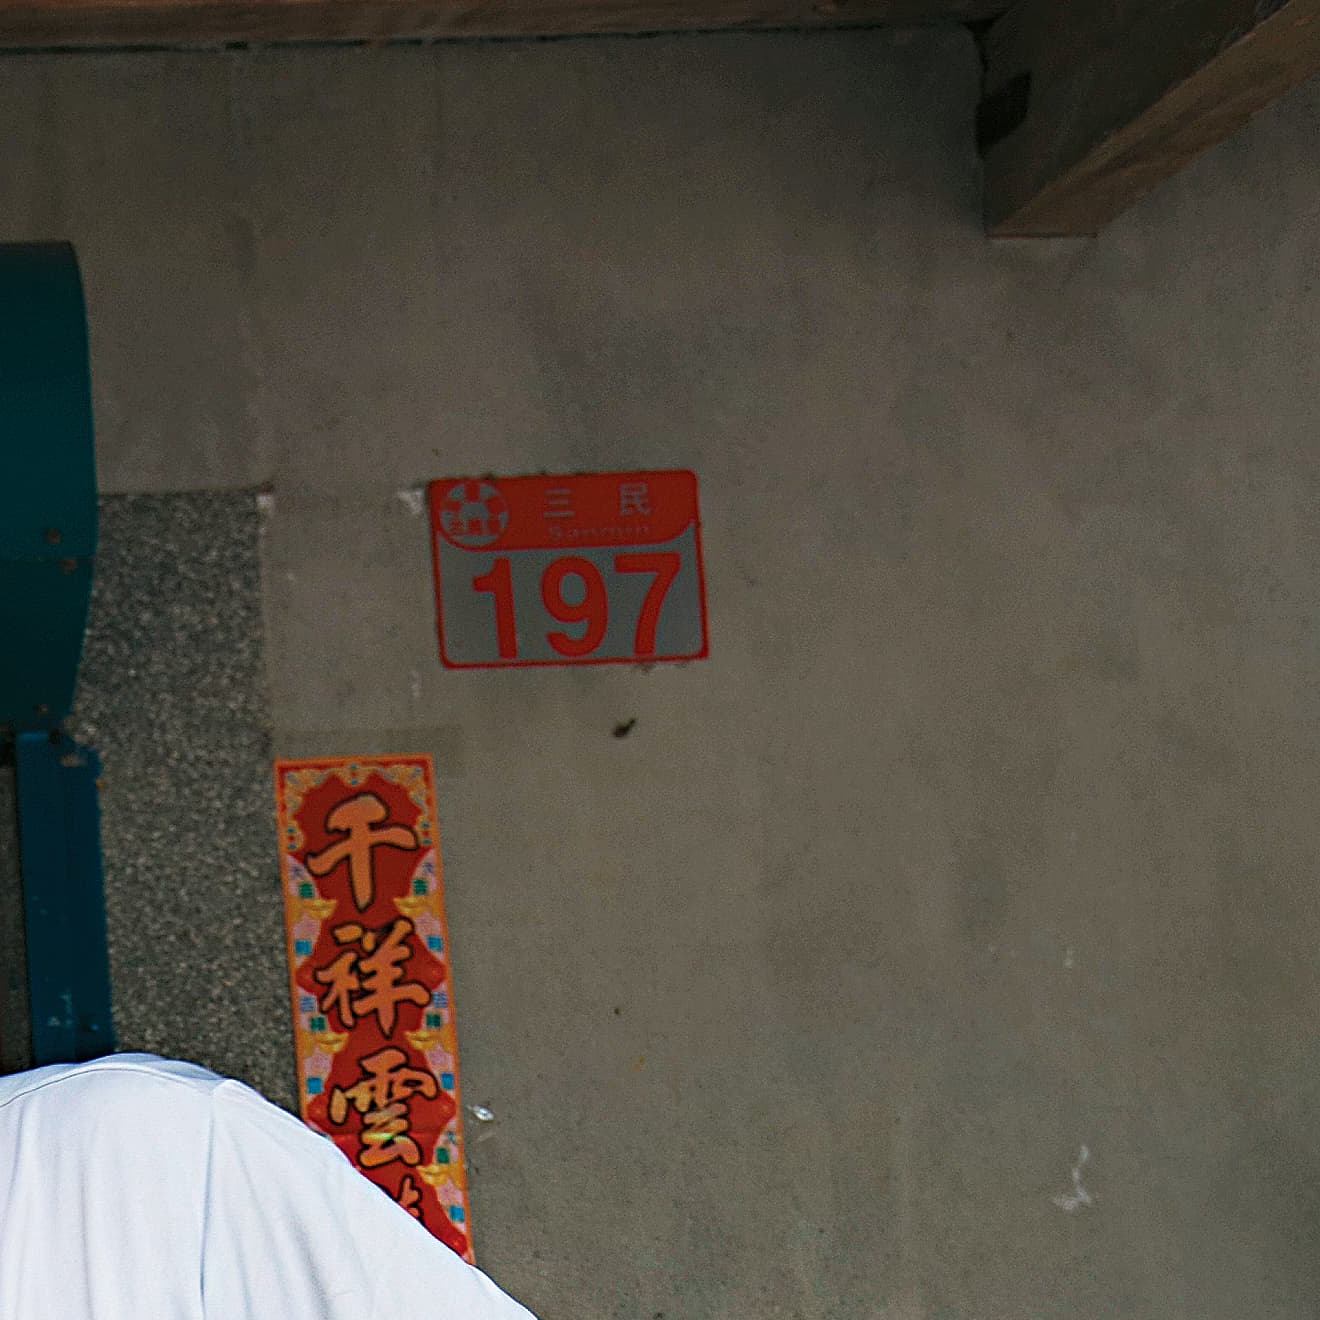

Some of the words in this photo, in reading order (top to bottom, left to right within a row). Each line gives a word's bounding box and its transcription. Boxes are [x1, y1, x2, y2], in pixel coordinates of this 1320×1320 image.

[472, 551, 682, 660] 197
[304, 790, 441, 1224] 千祥雲
